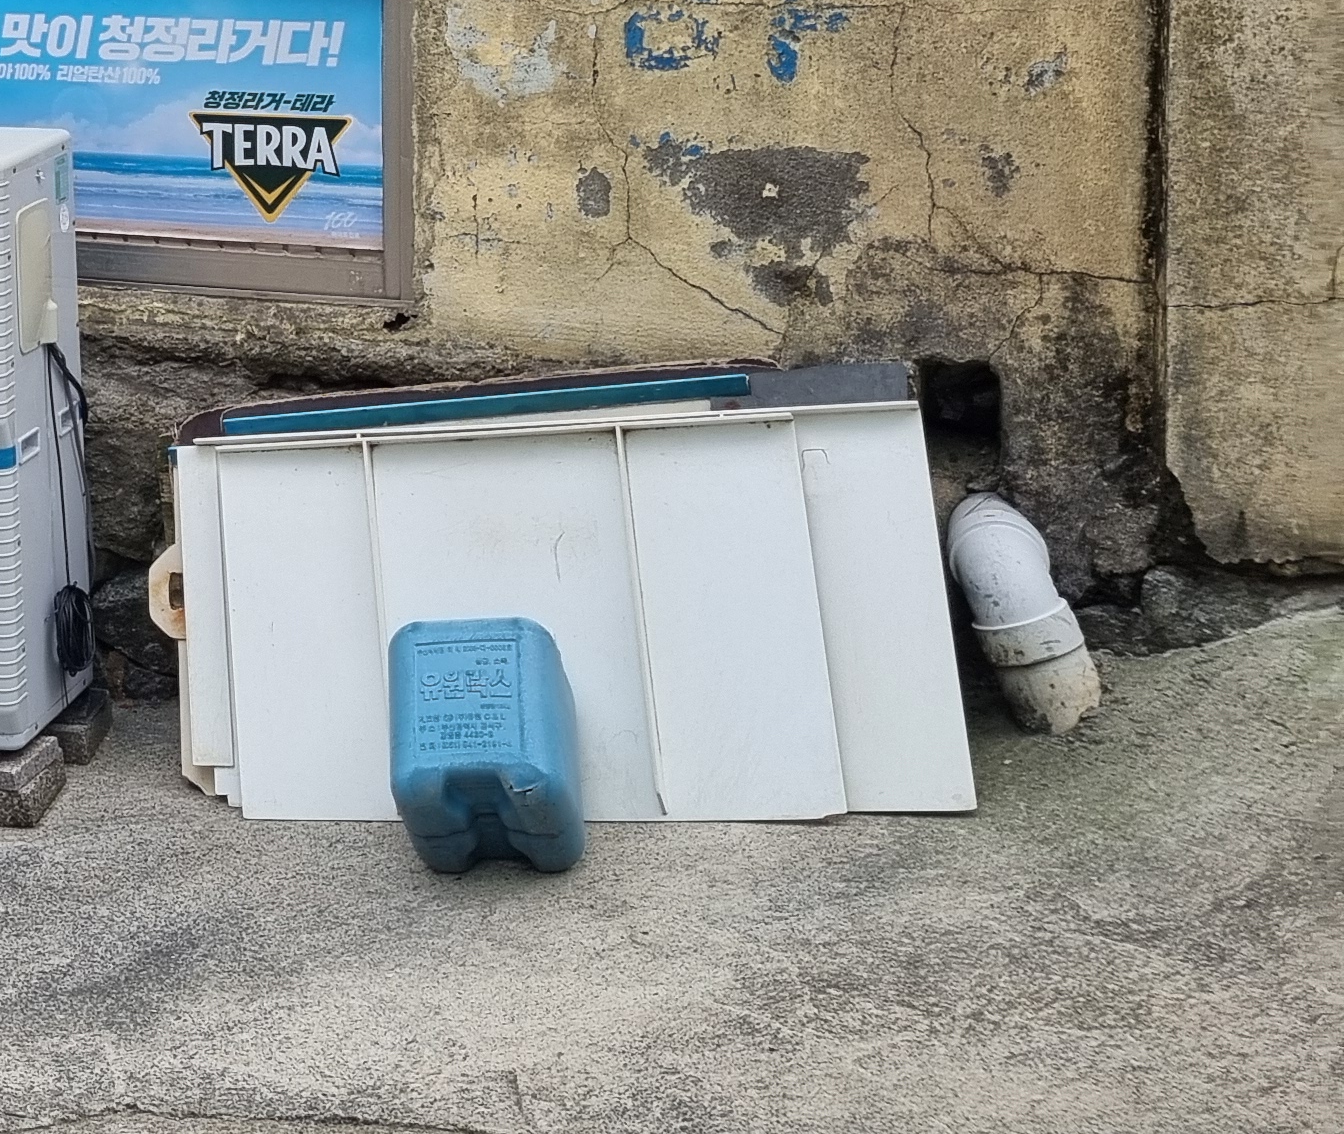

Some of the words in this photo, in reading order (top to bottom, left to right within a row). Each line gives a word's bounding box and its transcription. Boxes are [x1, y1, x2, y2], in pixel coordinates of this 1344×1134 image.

[0, 13, 94, 59] 맛이
[98, 15, 345, 67] 청정라거다!
[203, 90, 336, 113] 청정라거-테라
[201, 122, 339, 176] TERRA
